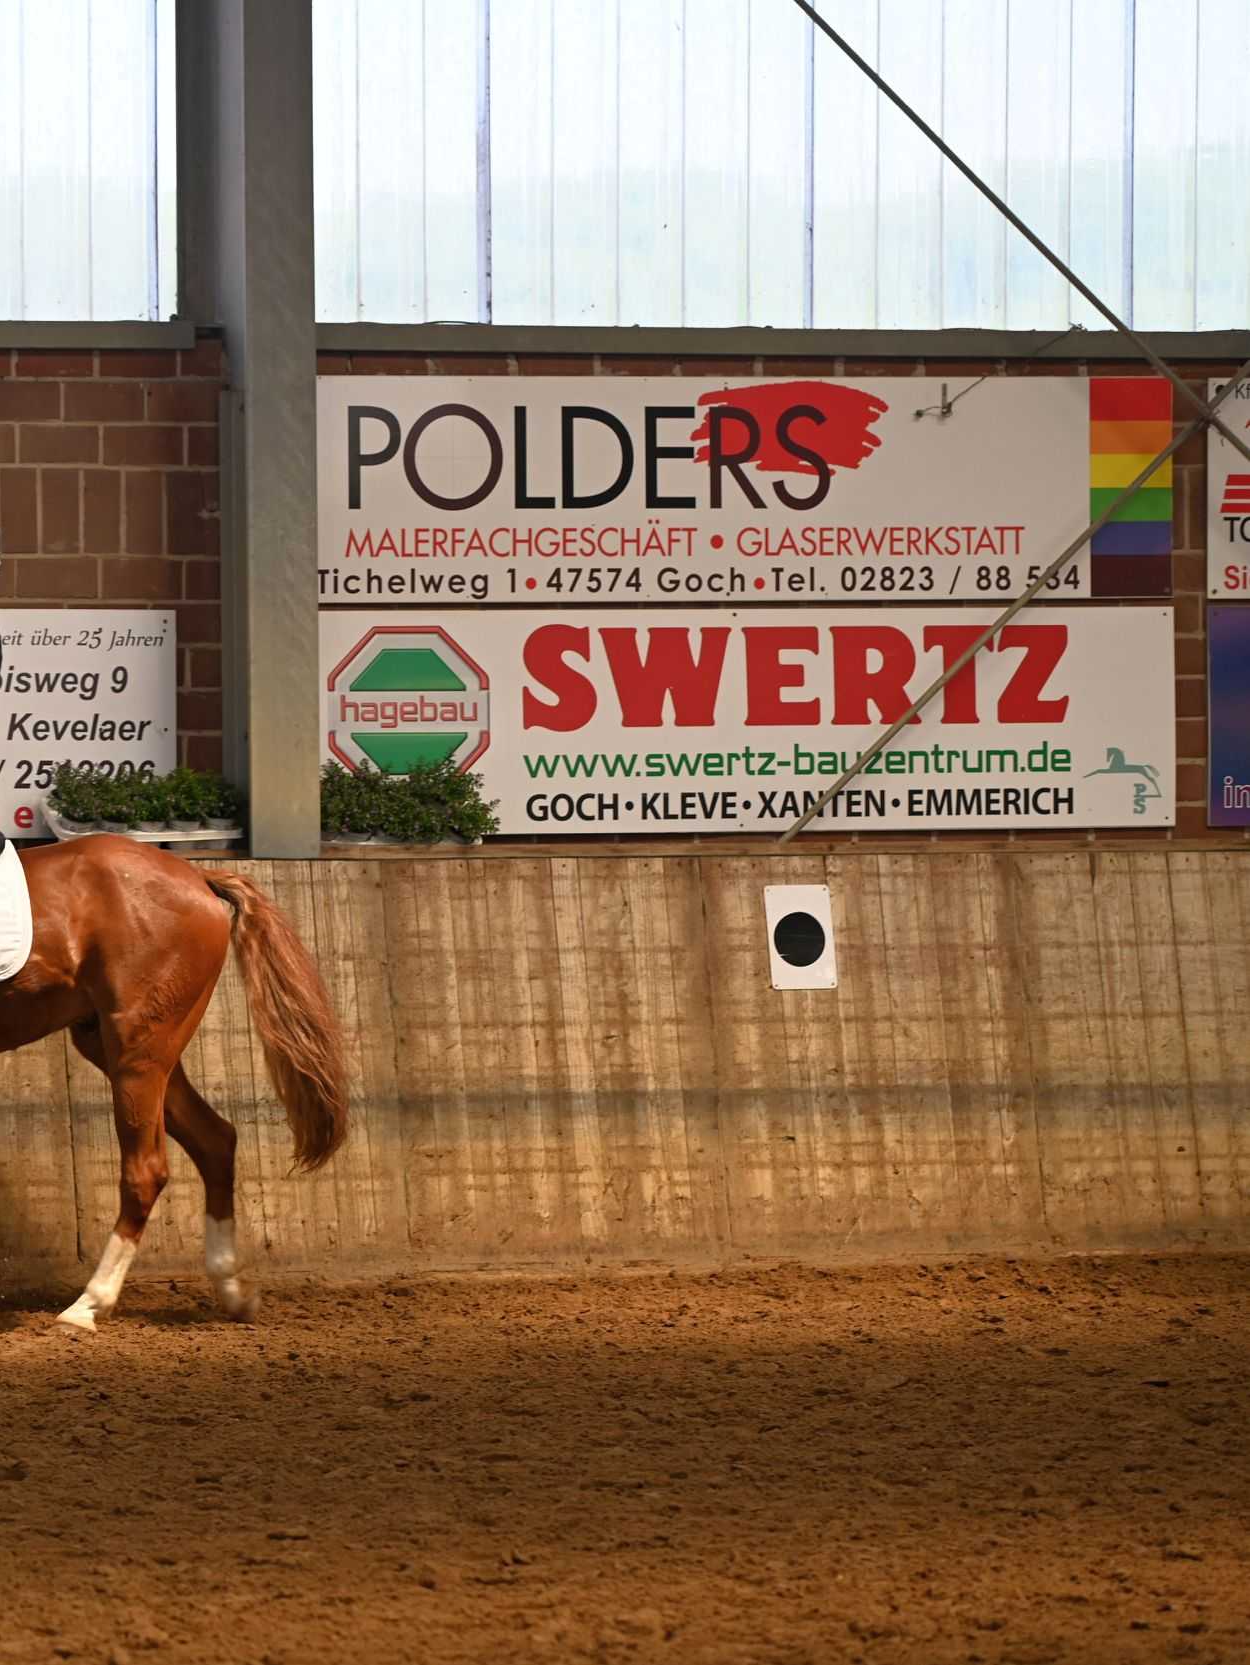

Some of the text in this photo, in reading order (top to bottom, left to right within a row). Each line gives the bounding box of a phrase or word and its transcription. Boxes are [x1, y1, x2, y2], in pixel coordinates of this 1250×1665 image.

[347, 403, 831, 511] POLDERS
[345, 519, 1025, 557] MALERFACHGESCHÄFT GLASERWERKSTATT
[318, 568, 489, 600] Tichelweg
[506, 568, 517, 593] 1
[546, 567, 643, 593] 47574
[656, 566, 746, 594] Goch
[771, 567, 826, 593] Tel.
[840, 566, 935, 592] 02823
[975, 565, 1011, 590] 88
[1, 630, 23, 646] eit
[30, 629, 71, 646] über
[77, 628, 101, 649] 25
[108, 629, 164, 651] Jahren
[110, 666, 128, 693] 9
[522, 623, 1070, 732] SWERTZ
[7, 712, 152, 741] Kevelaer
[340, 694, 478, 729] hagebau
[522, 740, 1072, 778] www.swertz-bauzentrum.de
[526, 792, 619, 821] GOCH
[641, 791, 738, 820] KLEVE
[907, 787, 1074, 816] EMMERICH
